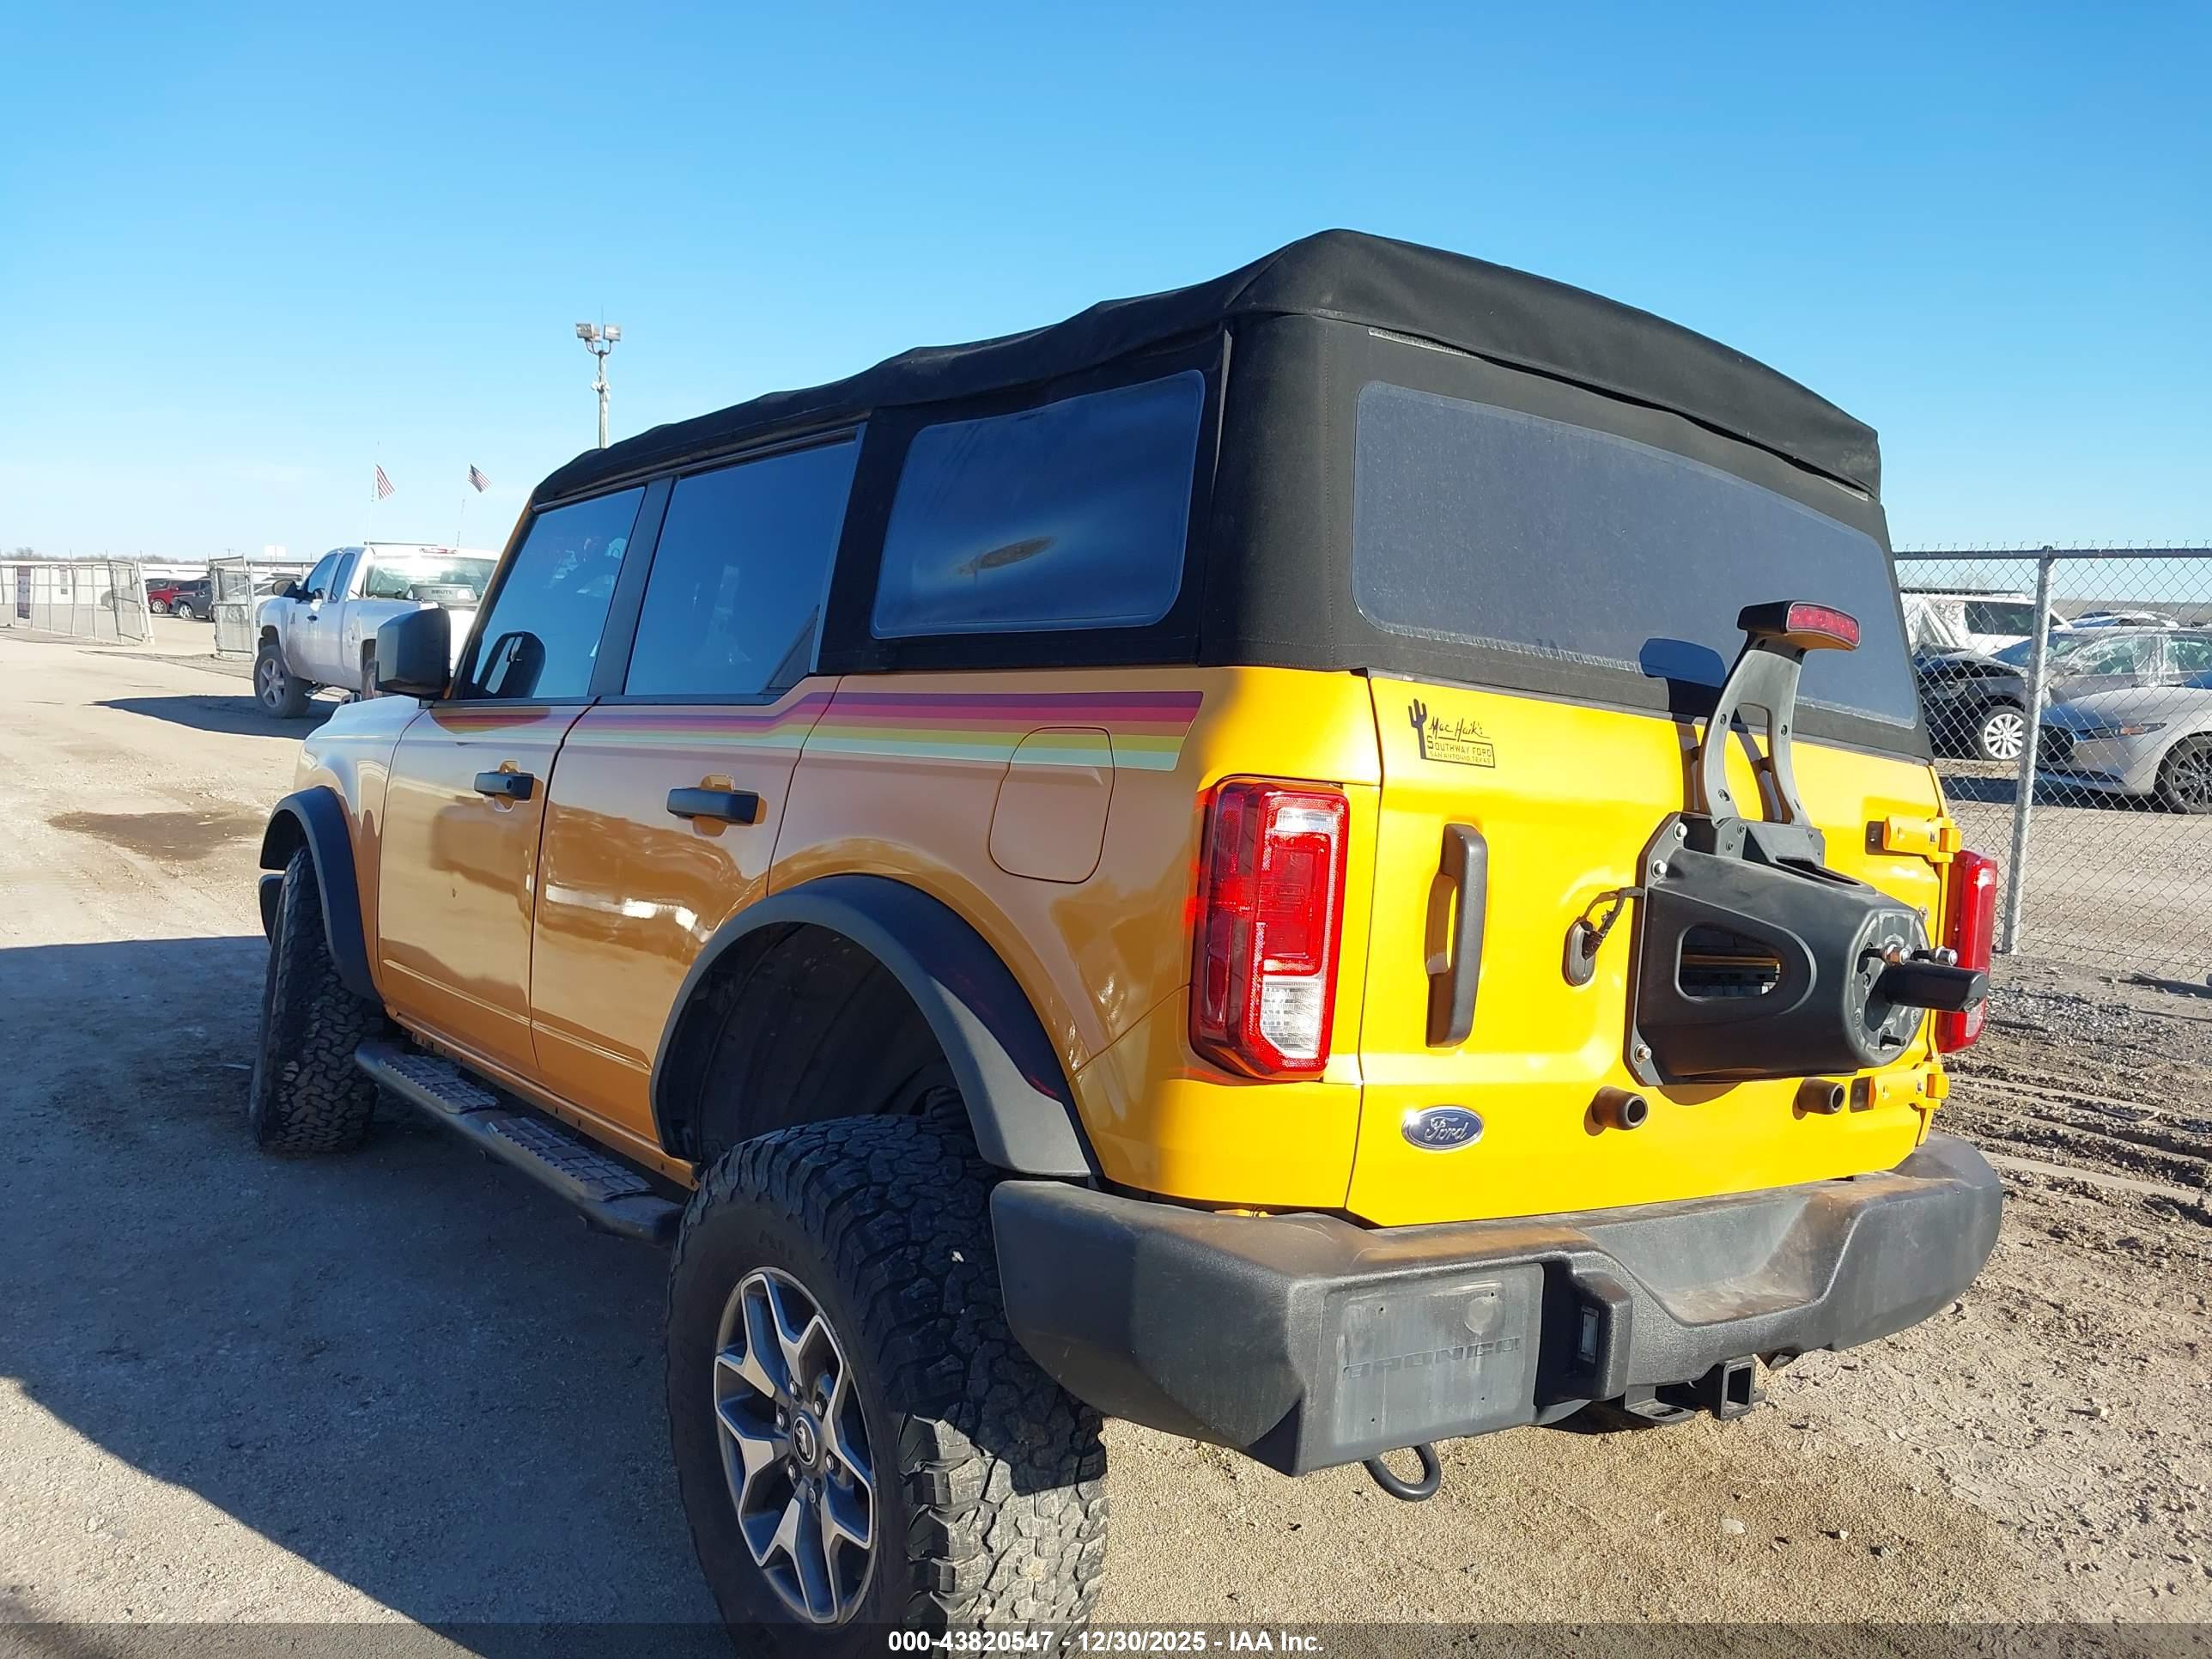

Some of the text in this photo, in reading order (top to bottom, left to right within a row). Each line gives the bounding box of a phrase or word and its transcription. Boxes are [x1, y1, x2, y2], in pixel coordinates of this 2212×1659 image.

[1428, 715, 1453, 739] Mac
[1427, 735, 1492, 757] SOUTHWAY FORD
[1424, 1115, 1469, 1141] Ford
